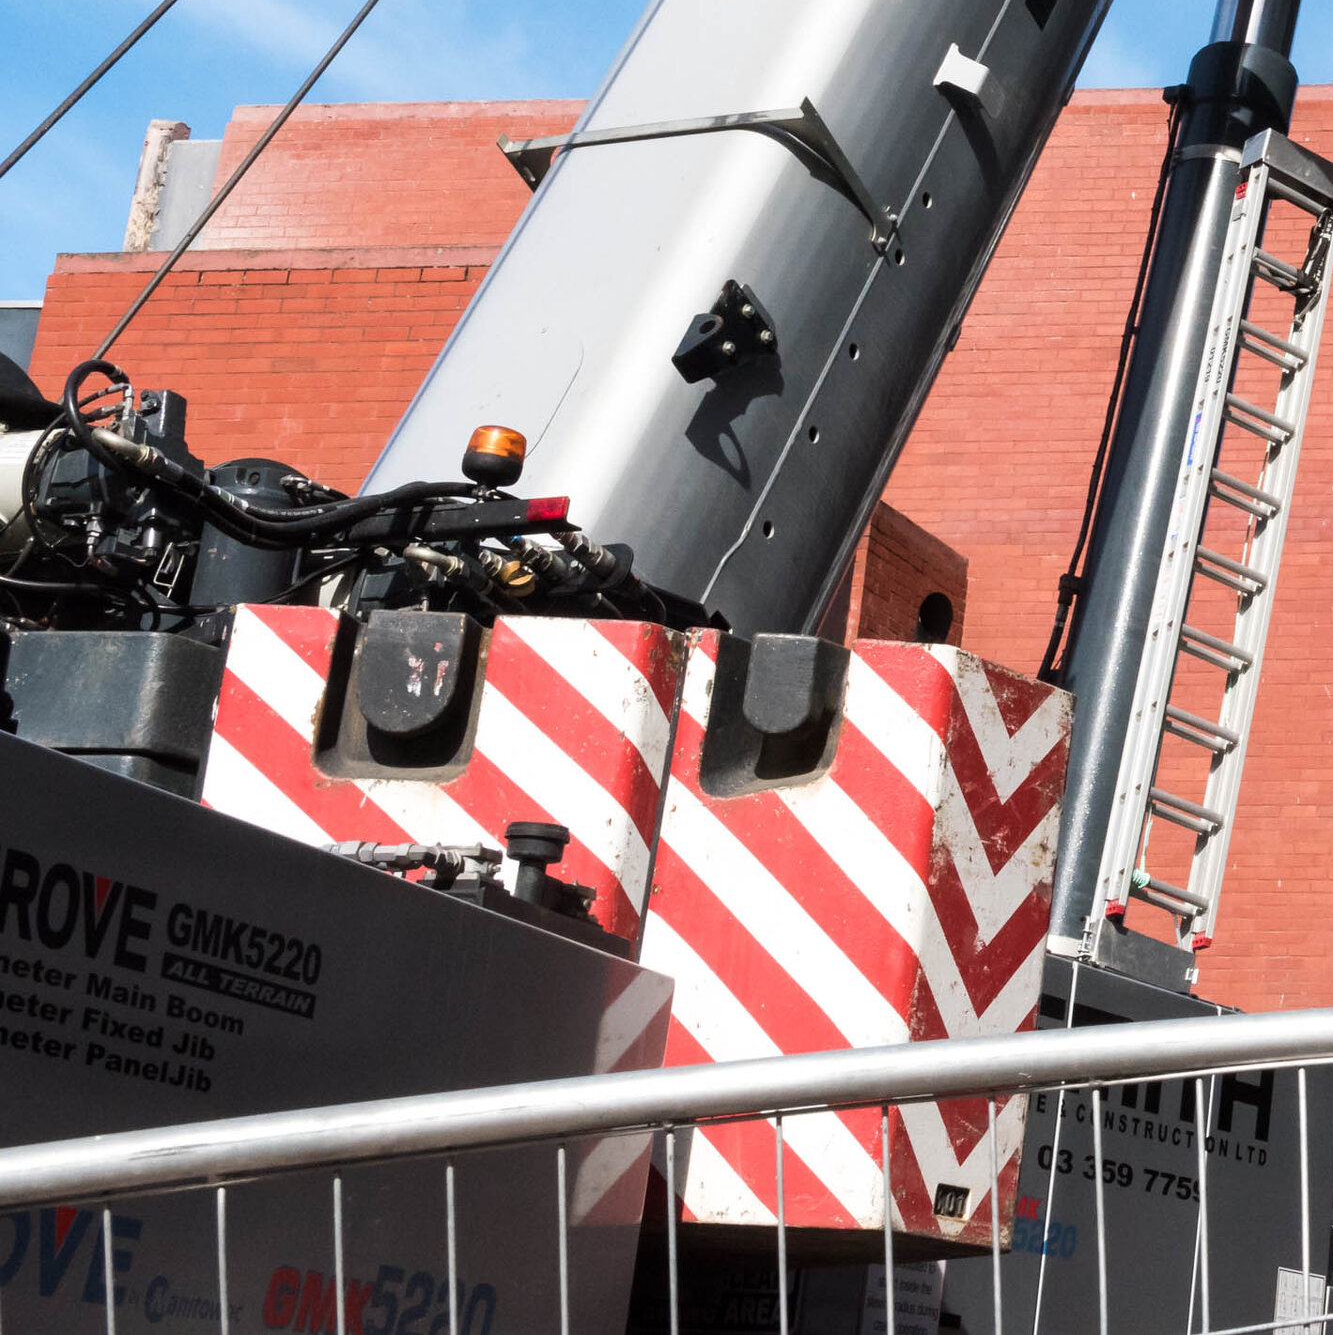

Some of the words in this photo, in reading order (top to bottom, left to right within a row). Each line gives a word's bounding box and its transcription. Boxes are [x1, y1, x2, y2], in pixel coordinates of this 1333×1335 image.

[167, 903, 322, 985] GMK5220
[86, 973, 157, 1012] Main
[167, 994, 245, 1036] Boom
[167, 960, 210, 985] ALL
[218, 972, 313, 1014] TERRAIN
[0, 991, 73, 1024] eter
[82, 1007, 164, 1048] Fixed
[172, 1032, 216, 1062] Jib
[1037, 1145, 1073, 1174] 03
[1083, 1155, 1133, 1187] 359
[1076, 1103, 1228, 1157] CNSTRUCTON
[1236, 1141, 1267, 1166] LTD
[262, 1265, 497, 1335] GMK5220
